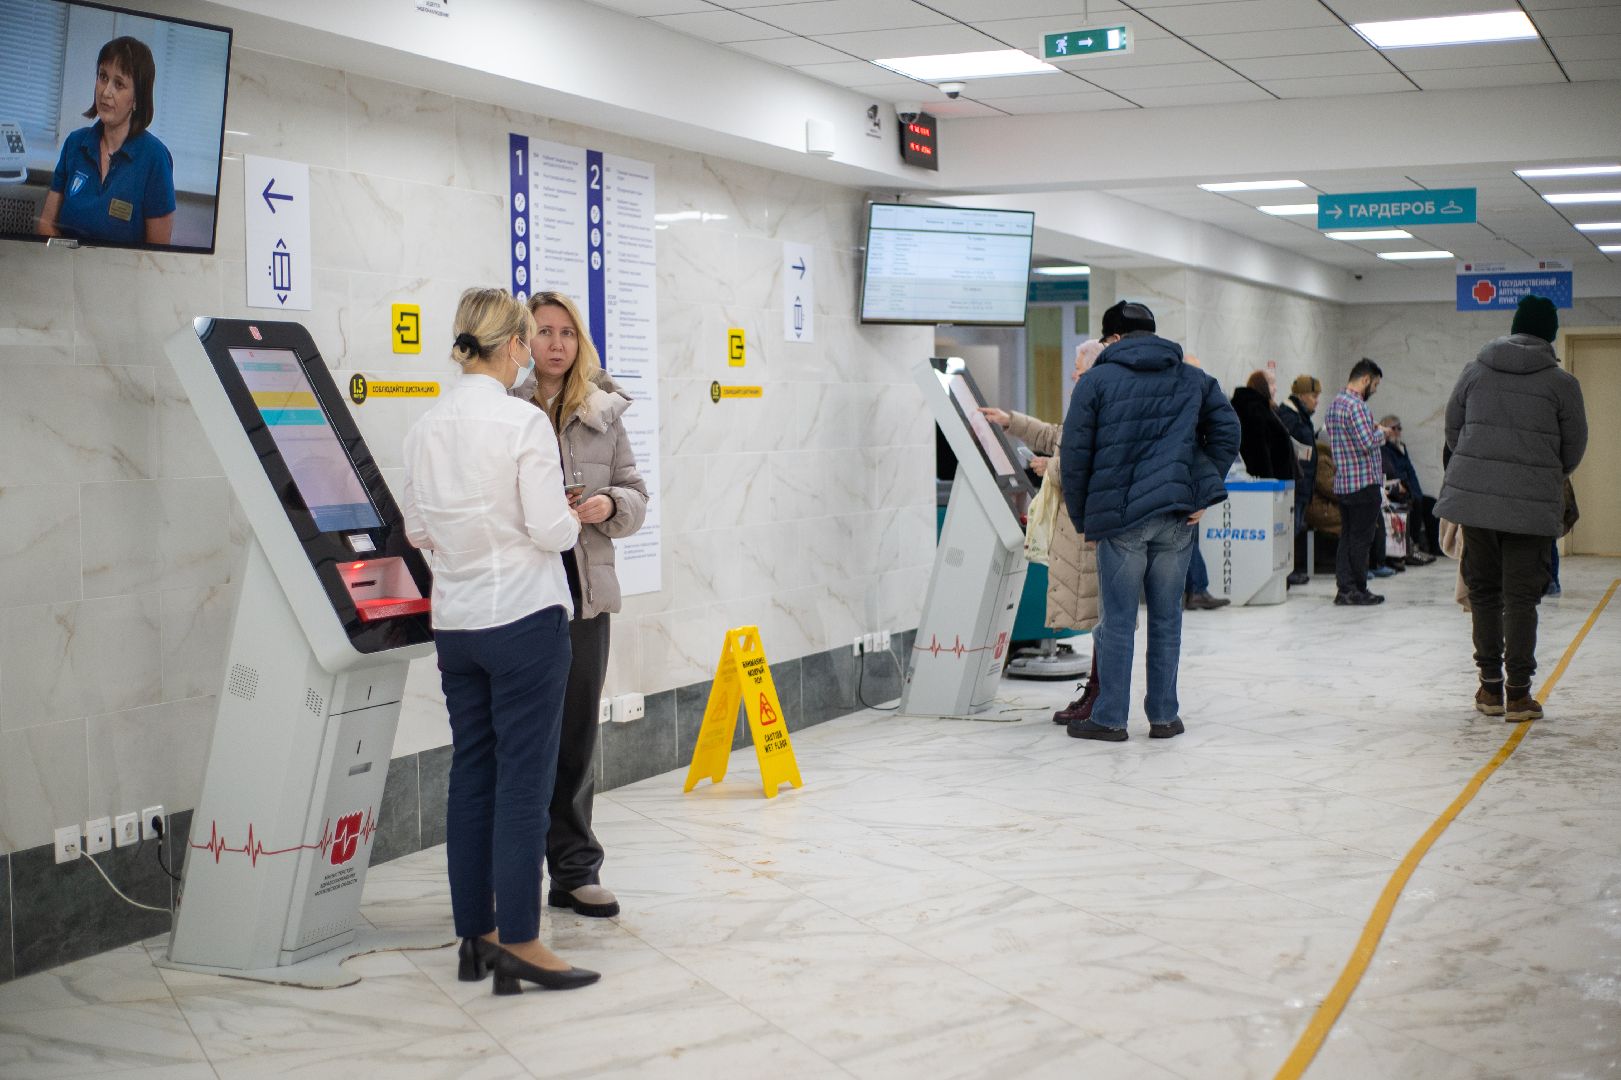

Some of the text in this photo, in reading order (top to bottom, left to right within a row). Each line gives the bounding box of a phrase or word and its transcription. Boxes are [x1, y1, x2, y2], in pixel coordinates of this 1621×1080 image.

[515, 149, 523, 176] 1
[590, 164, 600, 190] 2
[1349, 201, 1435, 219] ГАРДЕРОБ
[1499, 278, 1556, 288] ГОСУДАРСТВЕННЫЙ
[1499, 287, 1531, 296] АПТЕЧНЫЙ
[1499, 296, 1518, 305] ПУНКТ
[372, 385, 435, 394] СОБЛЮДАЙТЕ ДИСТАНЦИЮ
[1206, 528, 1266, 541] EXPRESS
[764, 731, 783, 742] CAUTION
[764, 739, 788, 753] WET FLOOR
